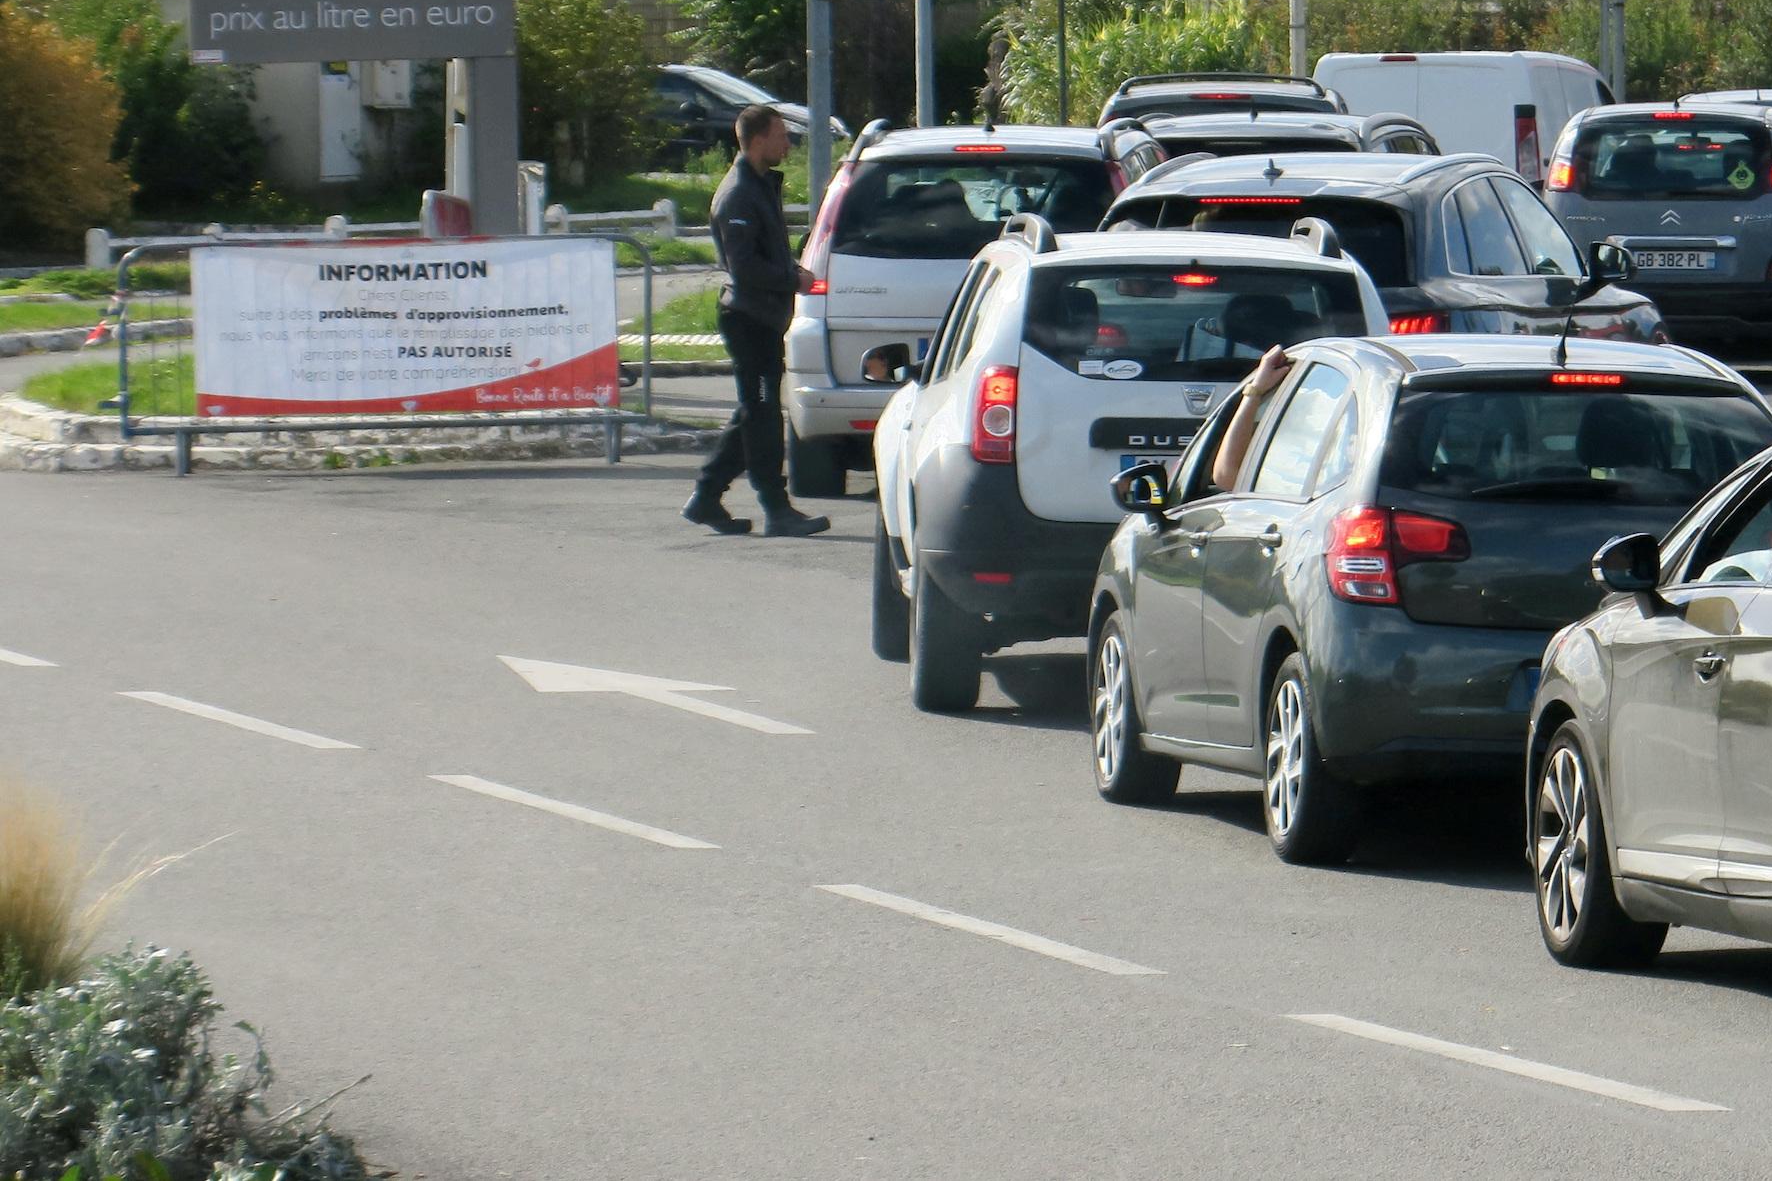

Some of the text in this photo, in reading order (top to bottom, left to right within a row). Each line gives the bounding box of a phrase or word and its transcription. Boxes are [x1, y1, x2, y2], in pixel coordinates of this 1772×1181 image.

[210, 1, 494, 39] prix au litre en euro
[318, 259, 488, 282] INFORMATION
[318, 306, 398, 323] problèmes
[397, 345, 428, 359] PAS
[431, 342, 513, 359] AUTORISÉ
[1128, 435, 1193, 446] DUS
